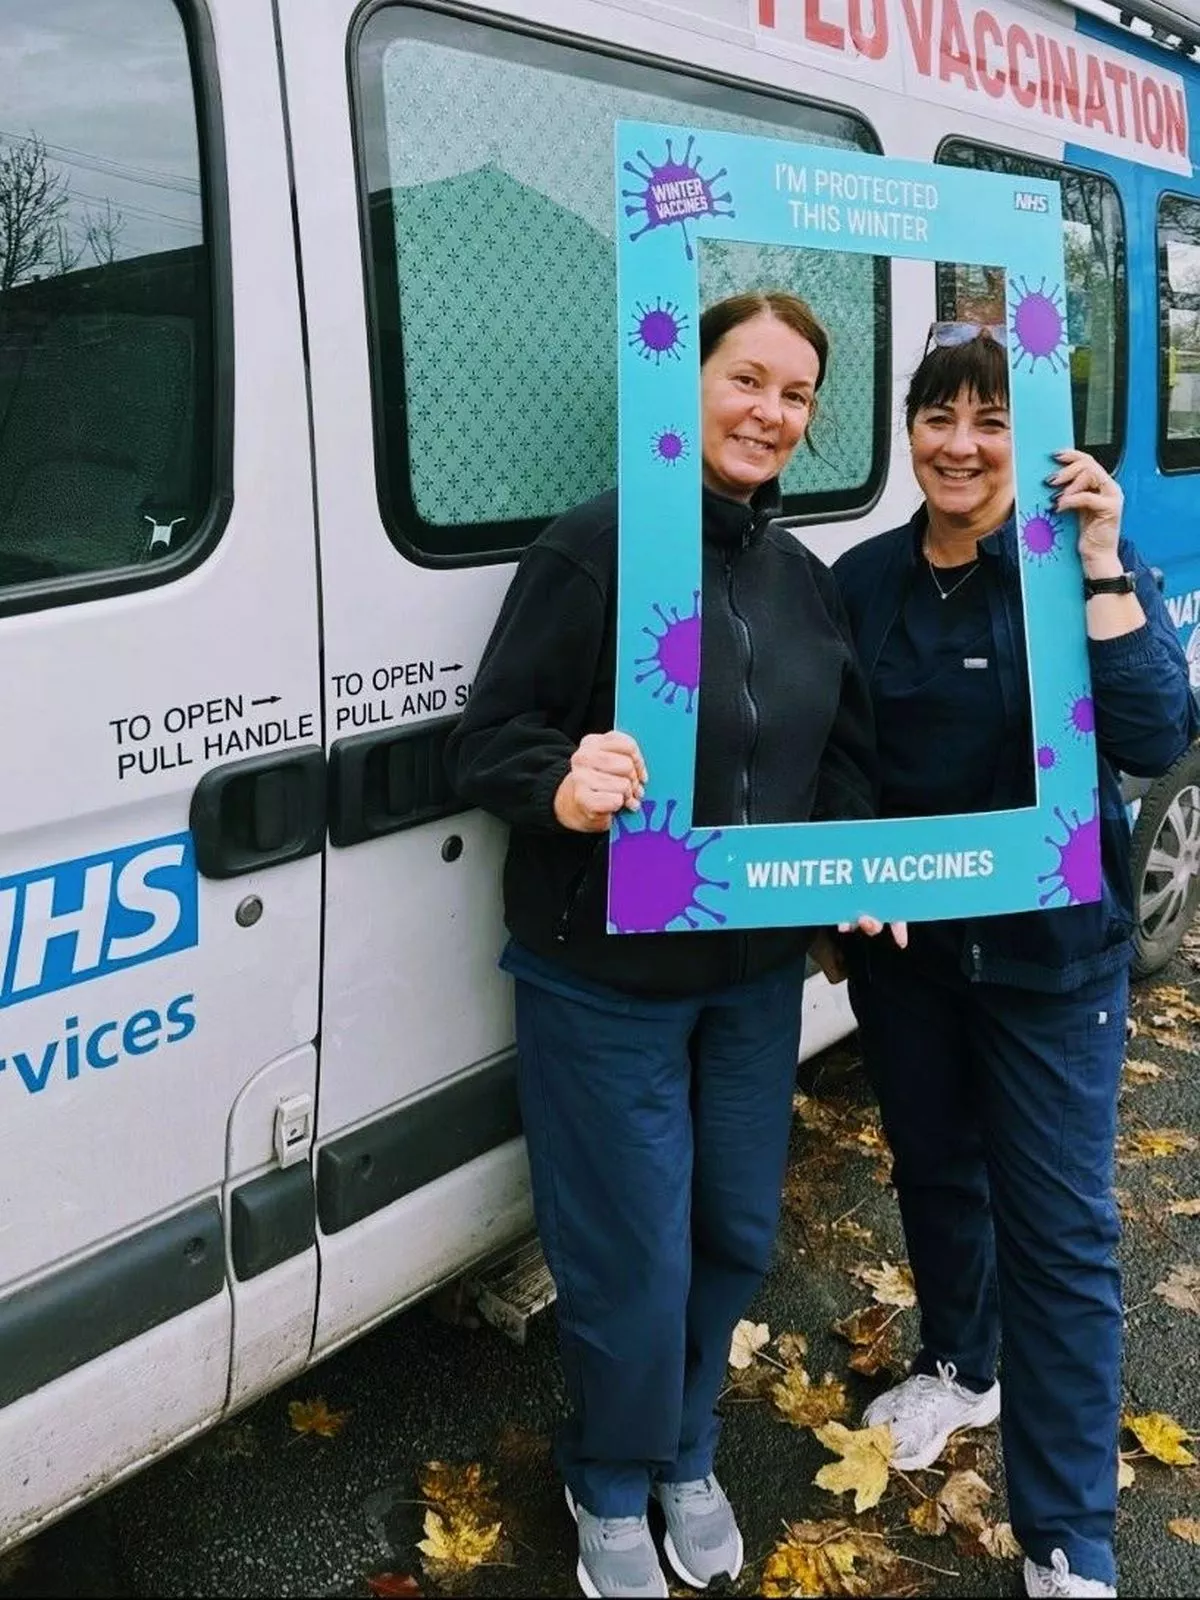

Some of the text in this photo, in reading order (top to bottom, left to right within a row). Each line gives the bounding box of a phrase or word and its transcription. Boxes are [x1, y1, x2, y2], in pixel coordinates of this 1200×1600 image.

[901, 0, 1186, 157] VACCINATION
[651, 179, 704, 202] WINTER
[655, 196, 708, 219] VACCINES
[775, 164, 939, 210] I'M PROTECTED
[1015, 193, 1048, 213] NHS
[788, 200, 929, 242] THIS WINTER
[331, 661, 434, 698] TO OPEN
[109, 694, 244, 744] TO OPEN
[336, 700, 394, 730] PULL
[401, 689, 447, 717] AND
[118, 713, 314, 780] PULL HANDLE
[746, 849, 994, 888] WINTER VACCINES
[0, 993, 196, 1094] vices
